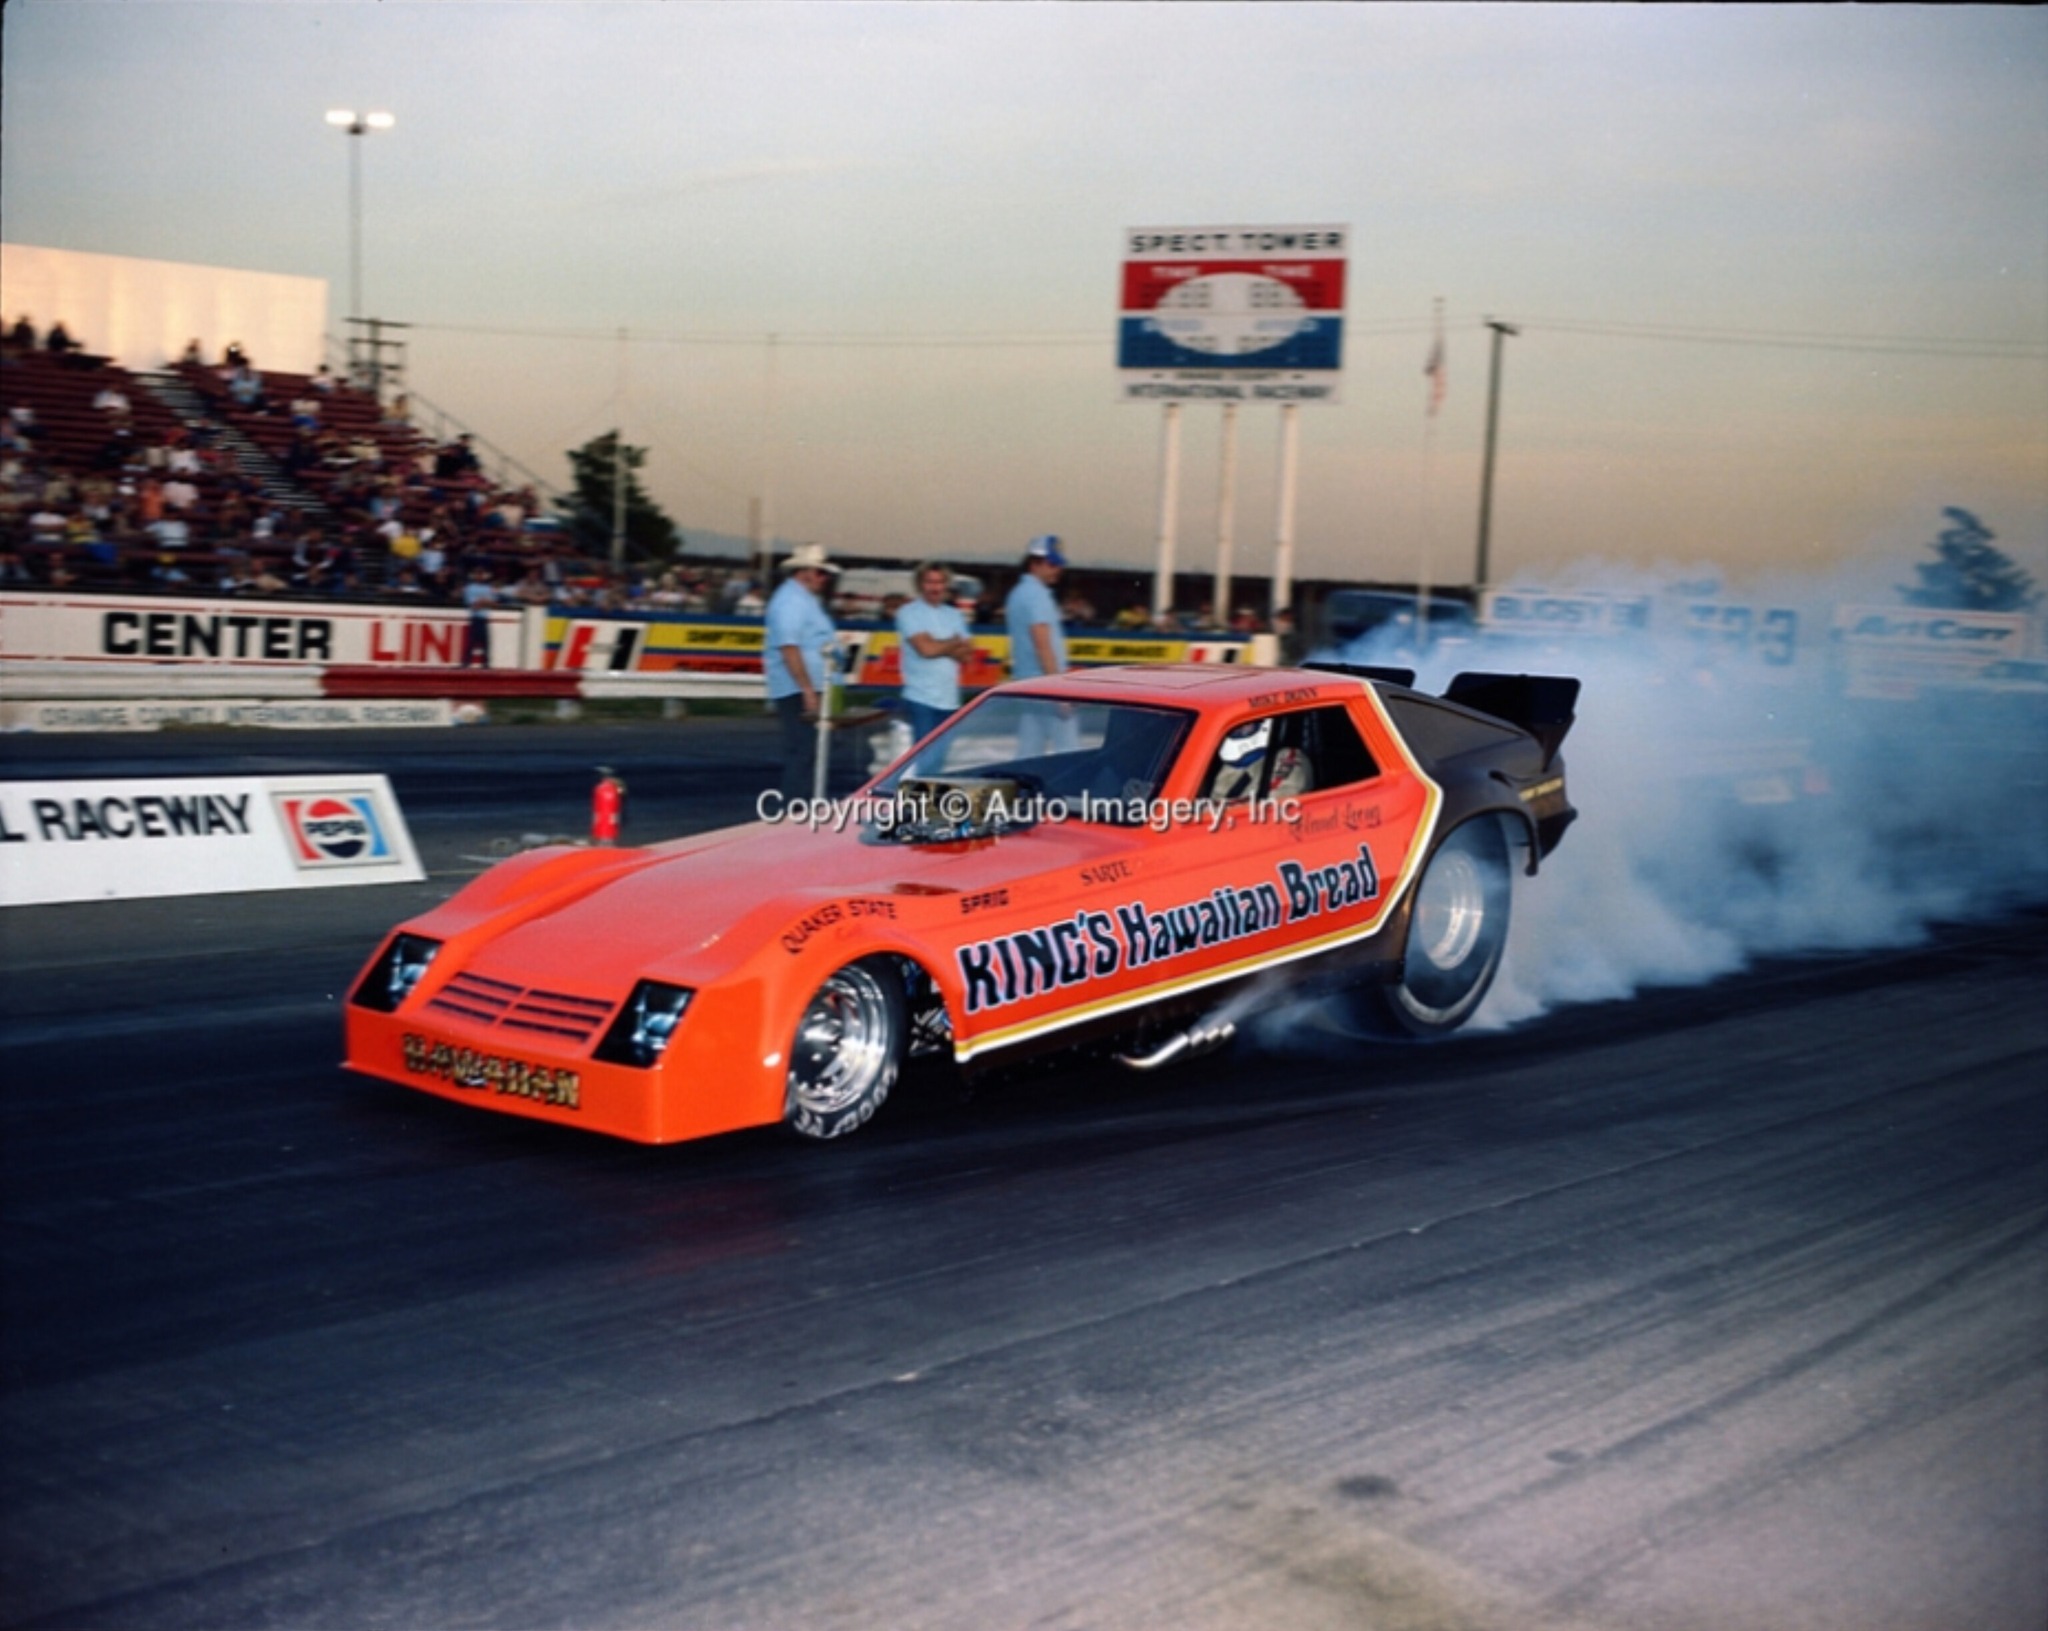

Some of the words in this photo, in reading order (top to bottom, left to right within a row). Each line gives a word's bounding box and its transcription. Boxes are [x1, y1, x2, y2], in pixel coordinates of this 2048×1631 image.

[1239, 230, 1343, 251] TOWER
[105, 613, 330, 659] CENTER
[33, 794, 251, 842] RACEWAY
[304, 820, 367, 835] PEPSI
[782, 904, 844, 955] QUAKER
[848, 899, 897, 921] STATE
[958, 911, 1119, 1013] KING'S
[1123, 883, 1279, 968] Hawaiian
[1280, 846, 1378, 923] Bread
